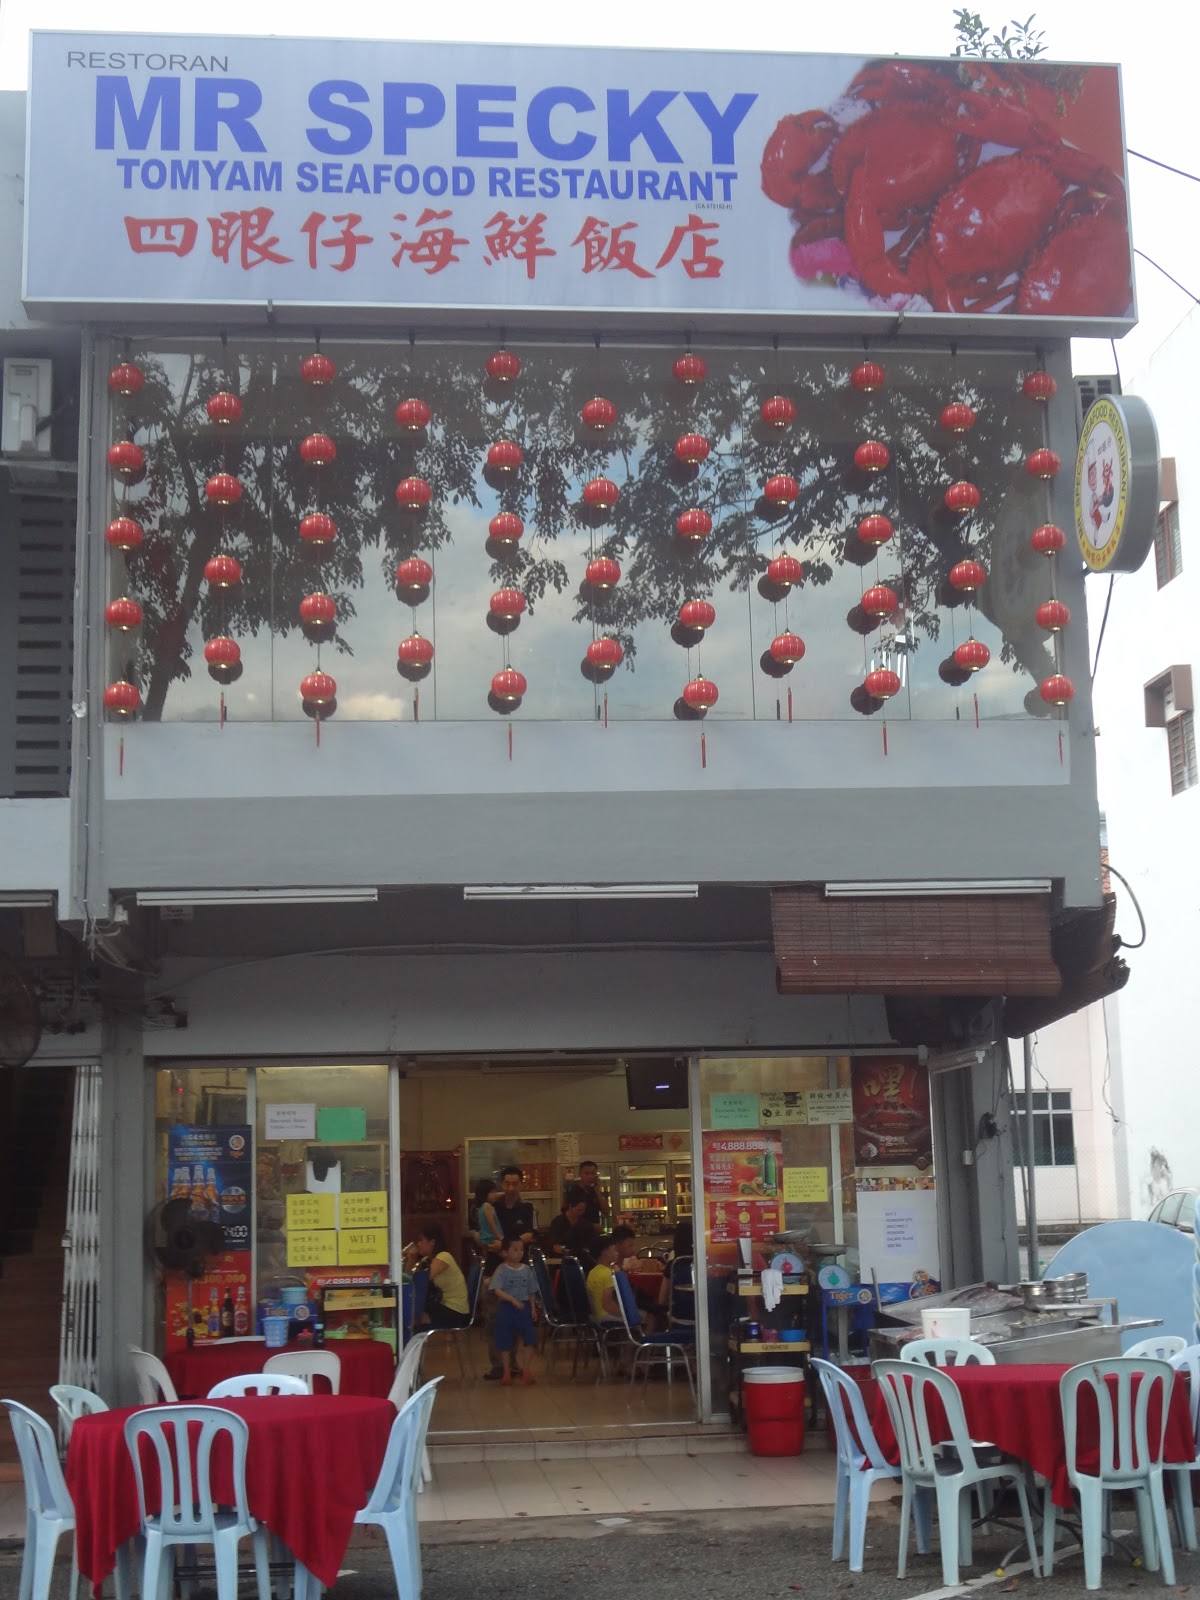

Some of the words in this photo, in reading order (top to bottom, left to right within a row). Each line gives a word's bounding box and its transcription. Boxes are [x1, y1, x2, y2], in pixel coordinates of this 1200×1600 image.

[67, 51, 229, 73] RESTORAN
[95, 75, 268, 153] MR
[305, 80, 759, 165] SPECKY
[116, 158, 283, 192] TOMYAM
[296, 162, 475, 196] SEAFOOD
[488, 166, 738, 202] RESTAURANT
[124, 206, 724, 280] 四眼仔海鮮飯店
[1083, 406, 1108, 442] SEAFOOD
[1108, 409, 1128, 503] RESTAURANT
[349, 1235, 363, 1244] WI
[366, 1234, 376, 1244] FI
[829, 1291, 854, 1302] Tiger
